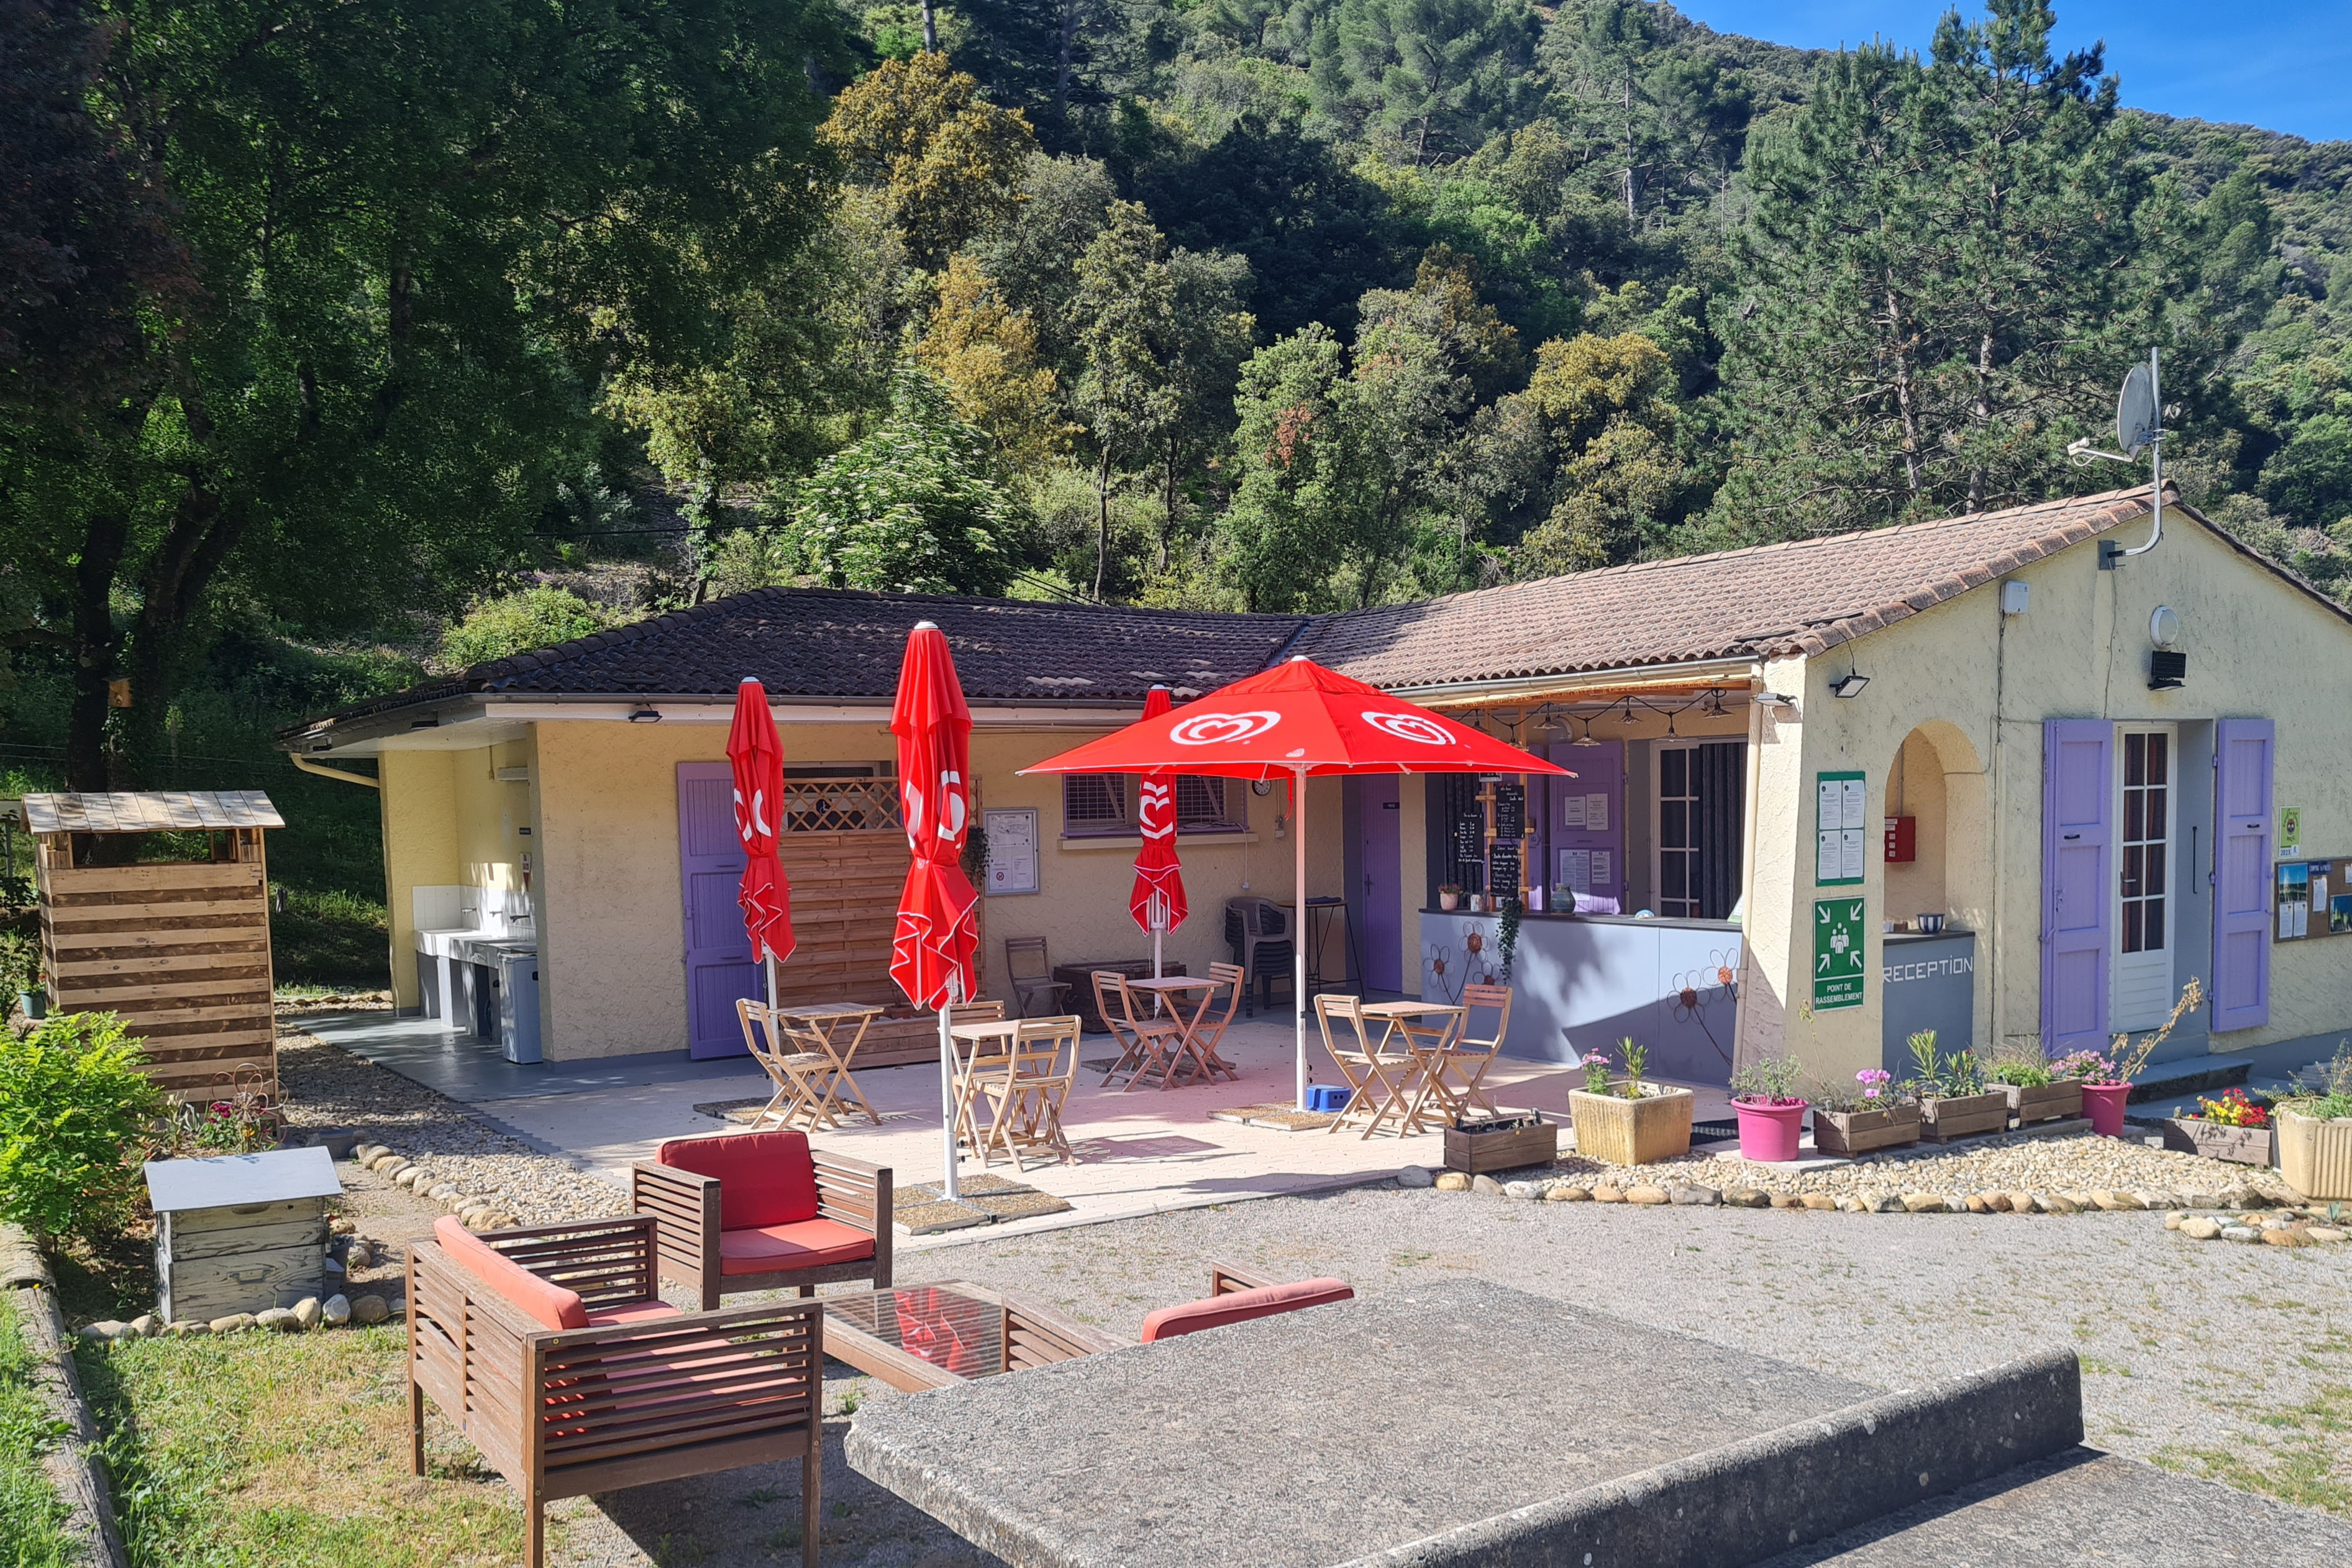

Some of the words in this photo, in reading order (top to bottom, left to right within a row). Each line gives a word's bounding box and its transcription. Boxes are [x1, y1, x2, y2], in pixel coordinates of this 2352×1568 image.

[1826, 983, 1843, 993] POINT
[1844, 983, 1852, 991] DE
[1815, 991, 1862, 1005] RASSEMBLEMENT
